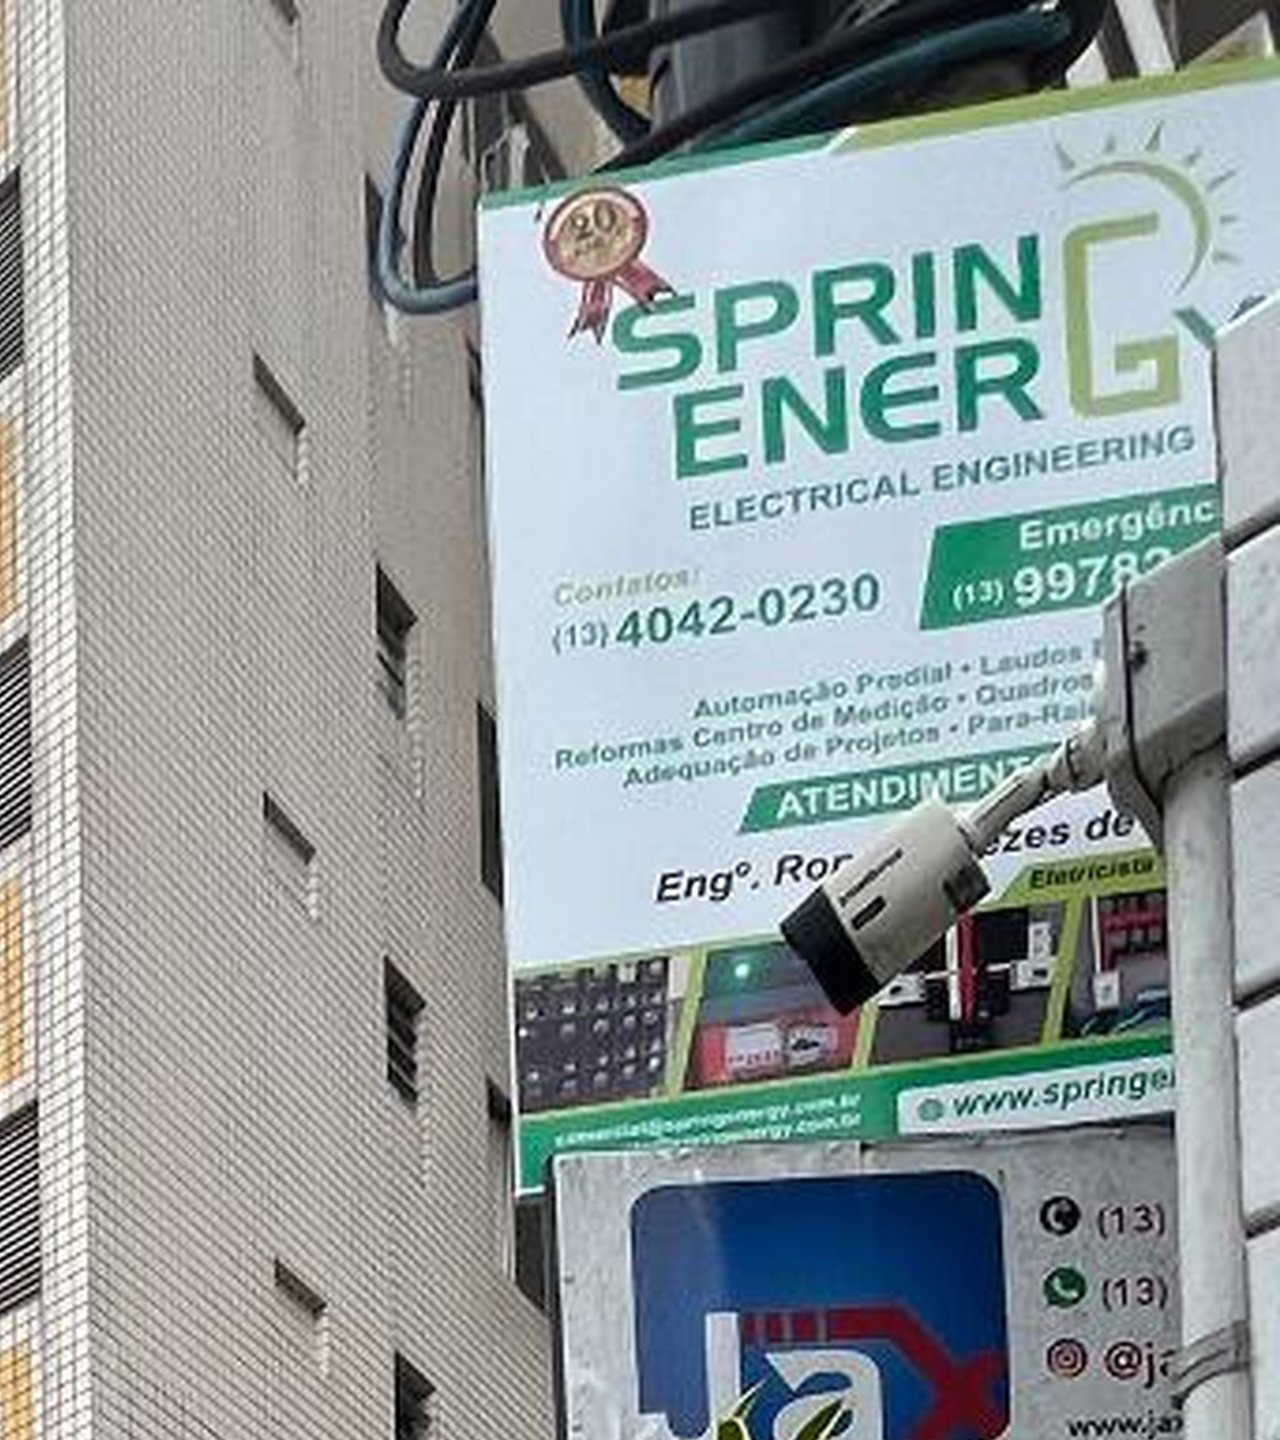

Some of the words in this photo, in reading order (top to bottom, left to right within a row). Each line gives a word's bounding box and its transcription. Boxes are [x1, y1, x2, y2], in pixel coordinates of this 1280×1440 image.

[690, 471, 920, 530] ELECTRICAL
[932, 426, 1195, 491] ENGINEERING
[1019, 500, 1216, 550] Emergênc
[952, 580, 1004, 610] (13)
[1012, 545, 1173, 607] 9978
[551, 620, 609, 655] (13)
[615, 572, 880, 648] 4042-0230
[693, 680, 848, 719] Automação
[856, 661, 952, 694] Predial
[979, 643, 1083, 676] Laudos
[554, 736, 684, 770] Reformas
[692, 719, 783, 748] Centro
[792, 712, 825, 732] de
[833, 695, 949, 726] Medição
[623, 749, 775, 790] Adequação
[784, 741, 821, 763] de
[825, 726, 940, 756] Projetos
[968, 699, 1096, 735] Para-Rai
[777, 756, 1034, 820] ATENDIMENT
[1029, 857, 1154, 890] Eletricista
[953, 1067, 1175, 1116] www.springe
[1097, 1202, 1166, 1240] (13)
[1102, 1276, 1168, 1311] (13)
